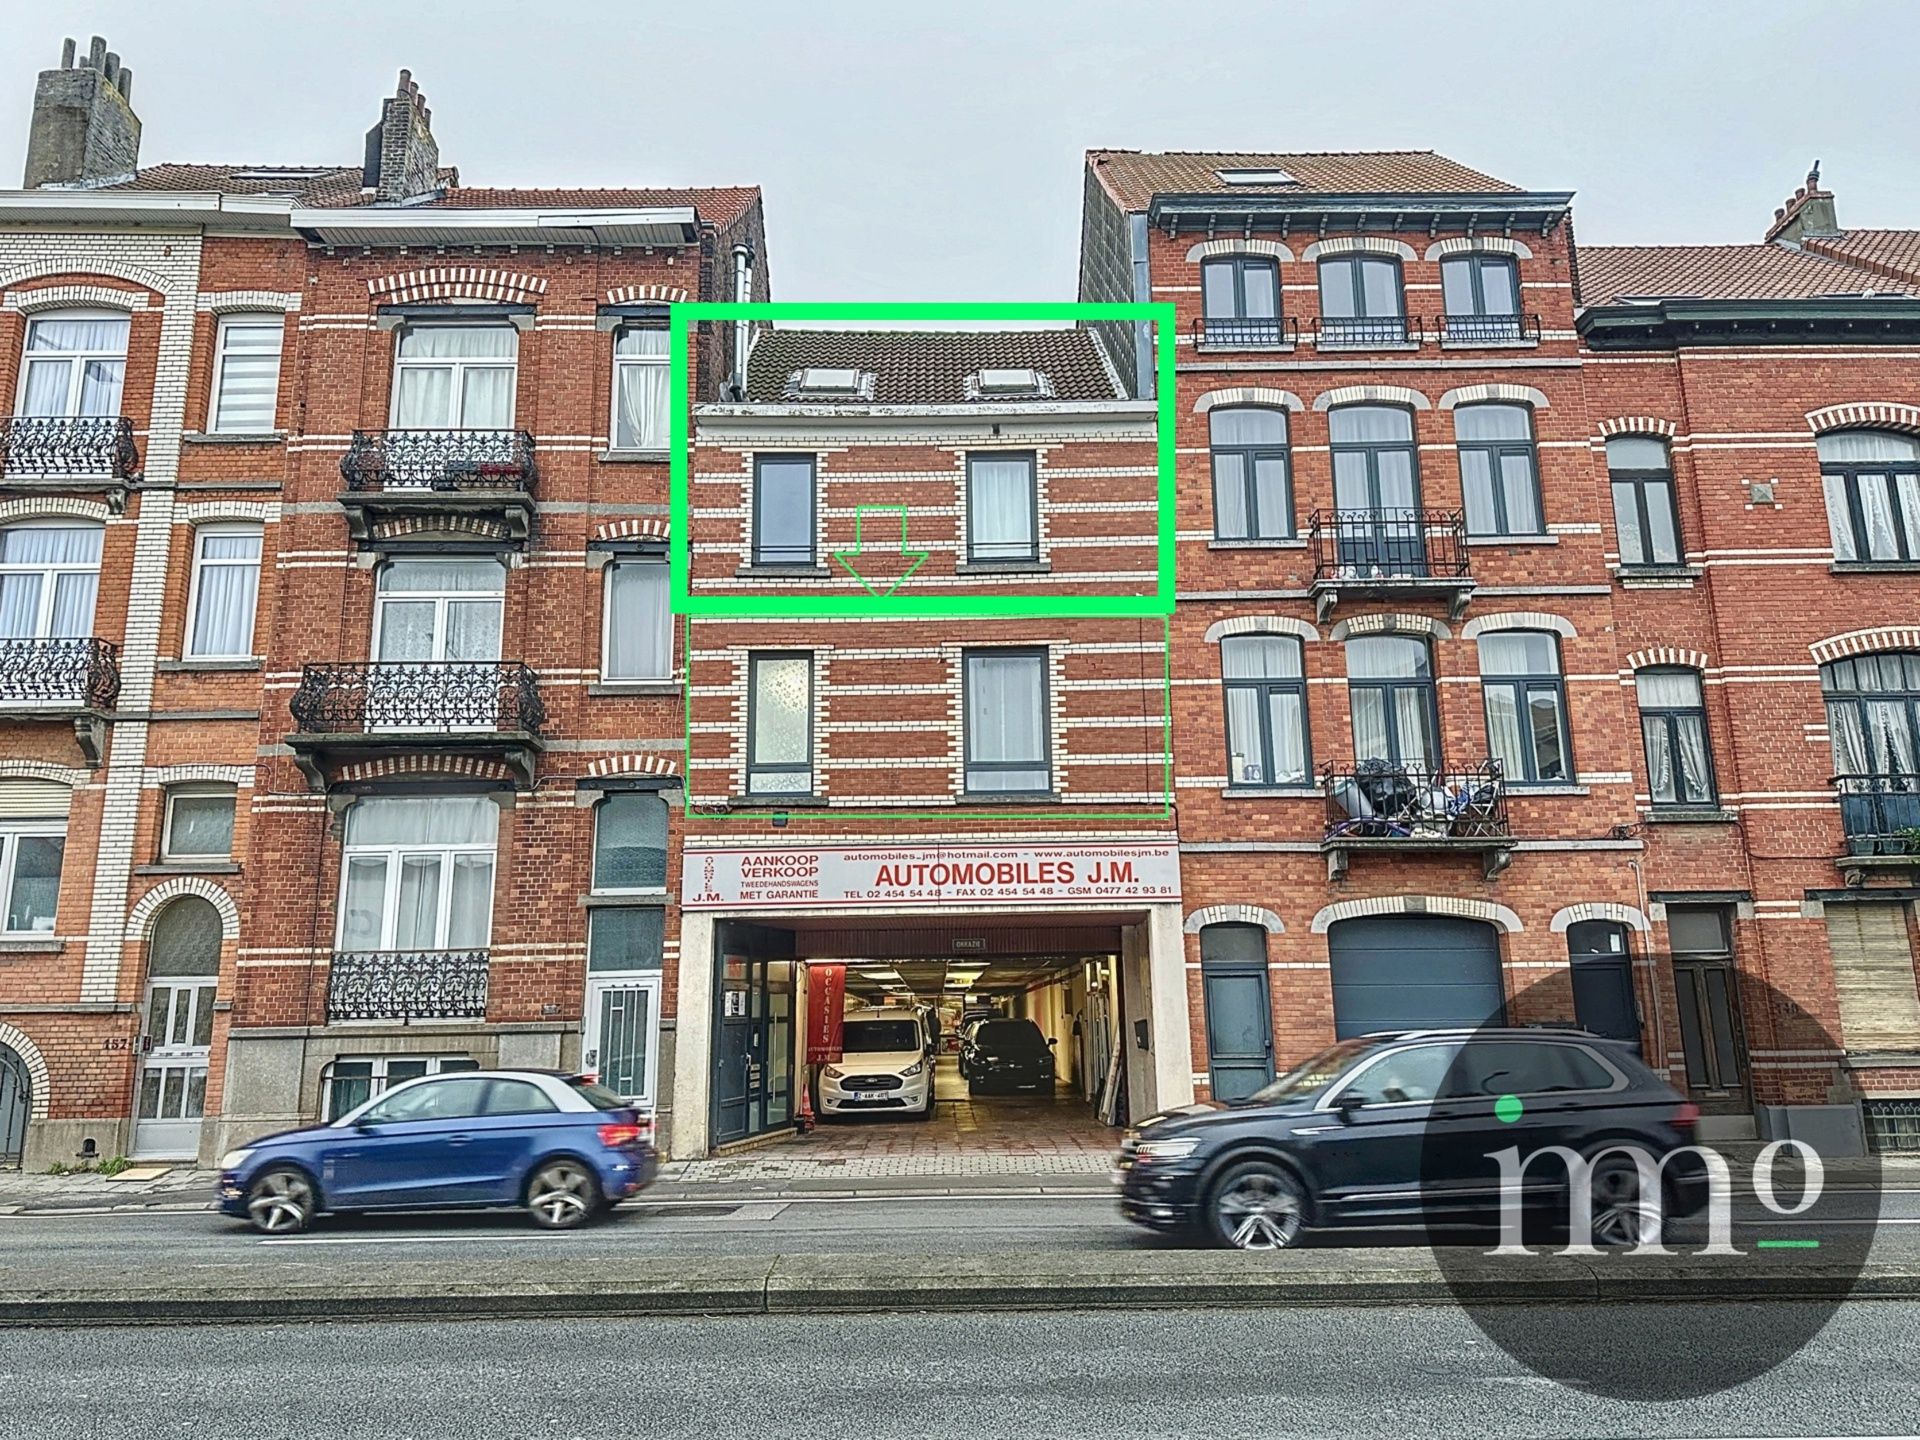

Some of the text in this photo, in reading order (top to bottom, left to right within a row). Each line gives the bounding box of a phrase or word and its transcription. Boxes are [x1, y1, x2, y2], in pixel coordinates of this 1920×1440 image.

[741, 855, 819, 867] AANKOOP
[844, 850, 1018, 861] automobiles_jm@hotmail.com
[1034, 849, 1169, 858] www.automobilesjm.be
[741, 866, 819, 878] VERKOOP
[875, 861, 1139, 887] AUTOMOBILES J.M.
[741, 880, 819, 888] TWEEDEHANDSWAGENS
[692, 893, 724, 902] J.M.
[740, 889, 819, 900] MET GARANTIE
[867, 890, 880, 898] 02
[885, 890, 905, 898] 454
[909, 889, 923, 897] 54
[927, 889, 941, 897] 48
[980, 888, 994, 896] 02
[998, 888, 1017, 896] 454
[1022, 887, 1035, 895] 54
[1039, 887, 1054, 895] 48
[1067, 887, 1091, 895] GSM
[1095, 886, 1121, 895] 0477
[1125, 886, 1138, 894] 42
[1142, 886, 1156, 894] 93
[1160, 886, 1172, 894] 81
[822, 968, 833, 1043] OCCASIES
[103, 1038, 128, 1050] 157
